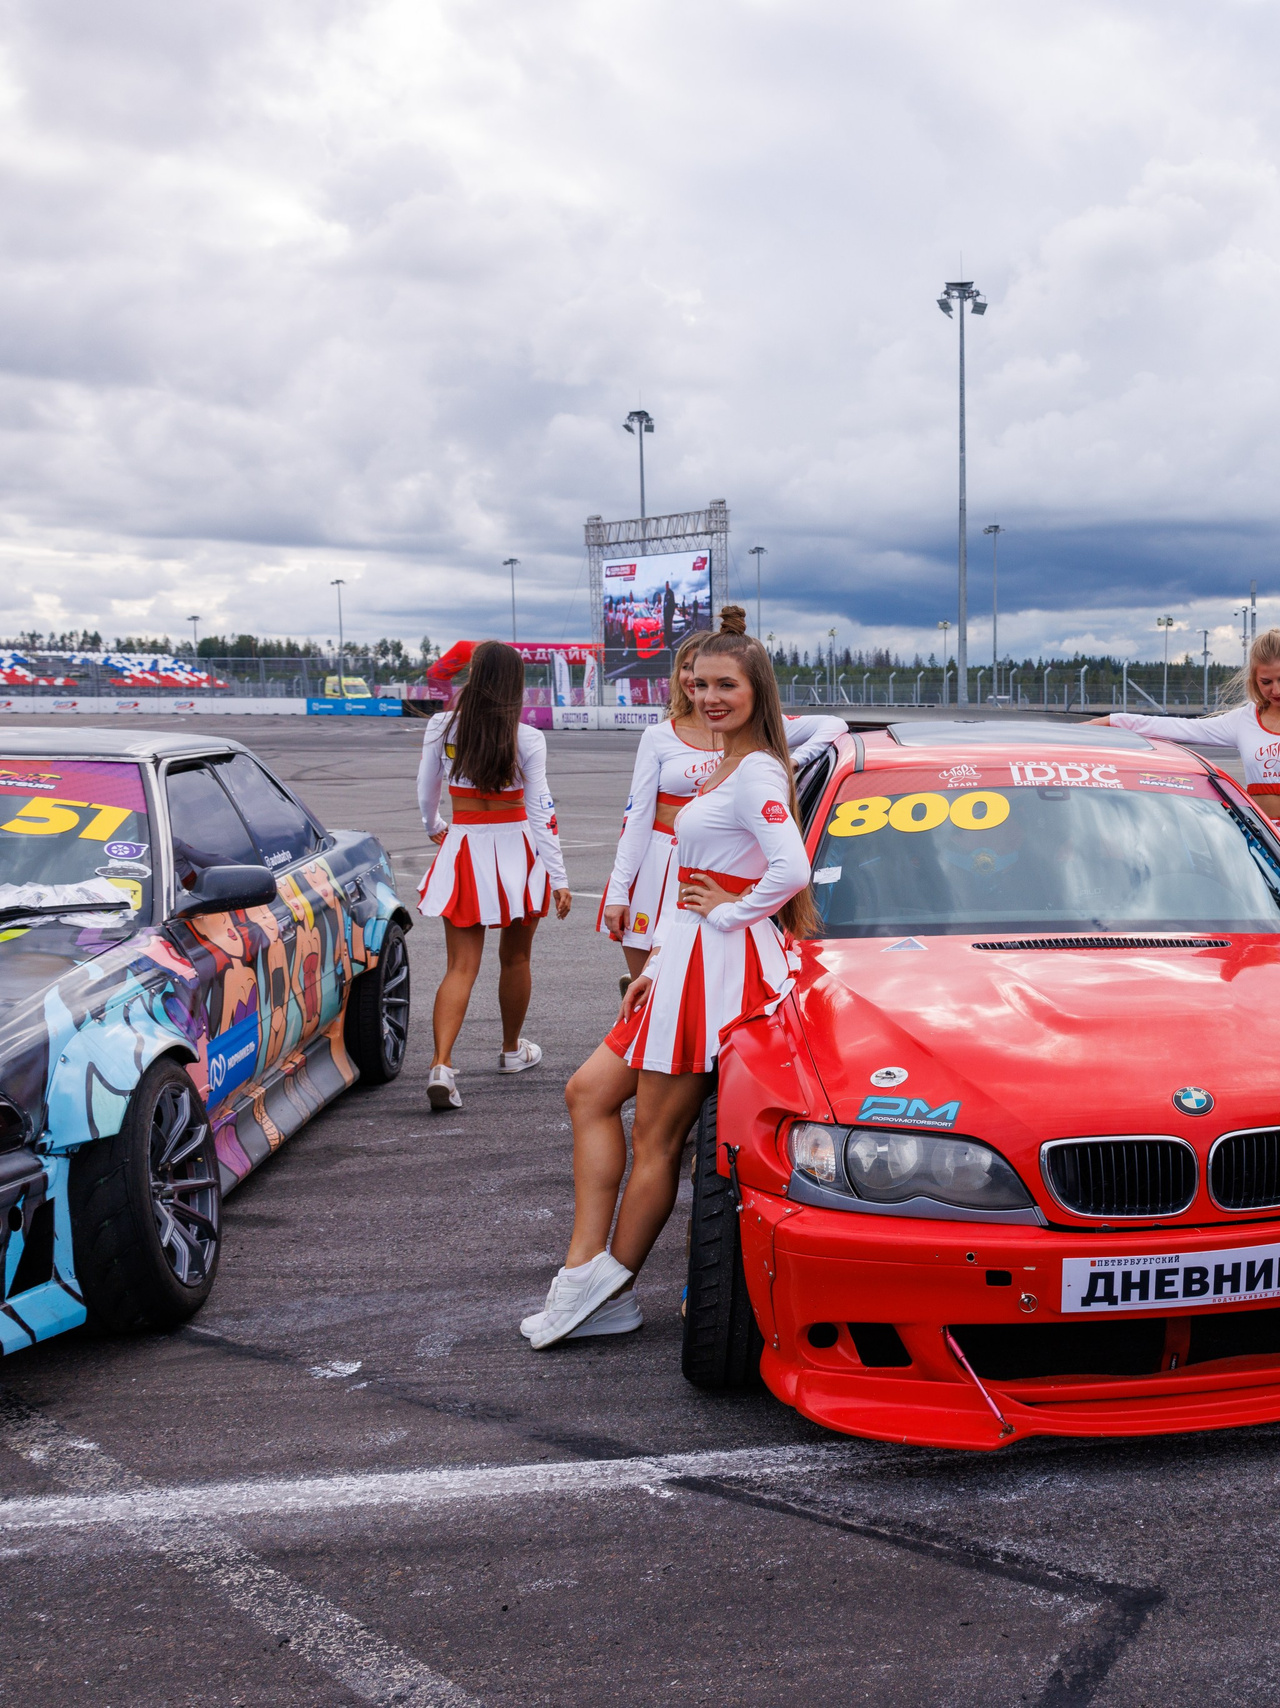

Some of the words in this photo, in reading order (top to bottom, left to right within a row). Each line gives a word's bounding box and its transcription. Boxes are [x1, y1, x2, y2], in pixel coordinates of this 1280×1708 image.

[614, 713, 647, 724] ИЗВЕСТИЯ
[1009, 765, 1121, 784] IDDC
[0, 779, 56, 790] ATSURI
[1052, 780, 1125, 789] CHALLENGE
[0, 796, 133, 842] 51
[828, 791, 1011, 838] 800
[872, 1115, 953, 1128] POPOVMOTORSPORT
[1097, 1254, 1181, 1267] ПЕТЕРБУРГСКИЙ
[1212, 1293, 1268, 1303] ПОДЧЕРКИВАЯ
